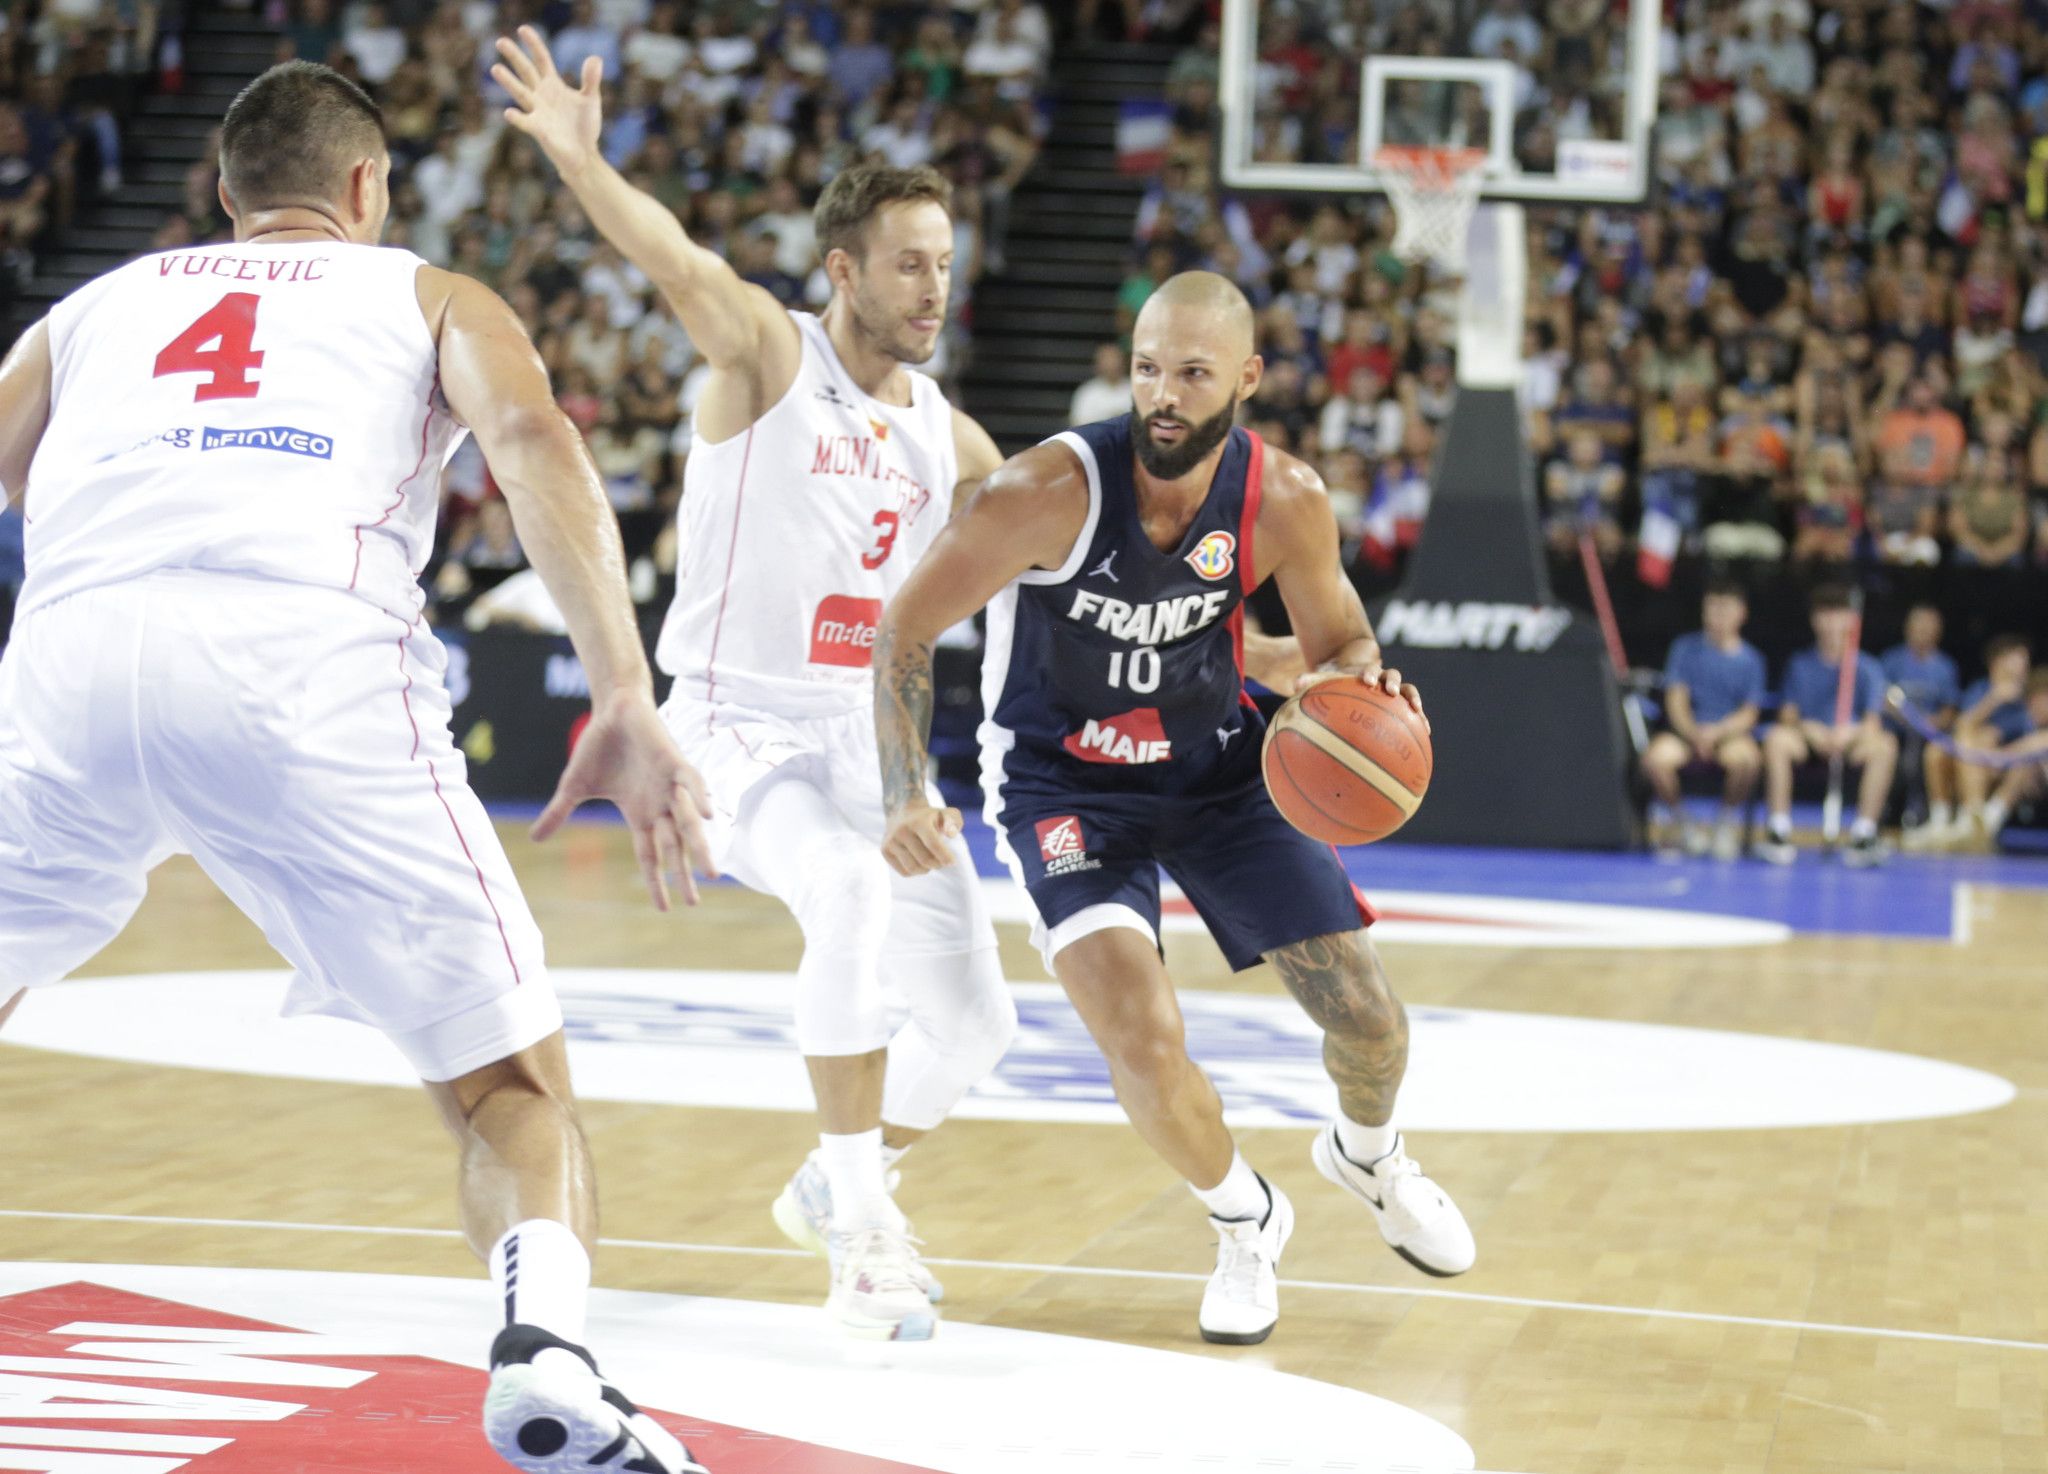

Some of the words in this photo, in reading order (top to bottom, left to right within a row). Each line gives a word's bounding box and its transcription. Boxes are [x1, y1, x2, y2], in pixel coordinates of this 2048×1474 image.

[152, 291, 266, 404] 4
[861, 508, 899, 571] 3
[816, 619, 880, 648] m:te
[1066, 588, 1230, 645] FRANCE
[1107, 645, 1162, 694] 10
[1078, 718, 1172, 765] MAIF
[1046, 850, 1087, 873] CAISSE
